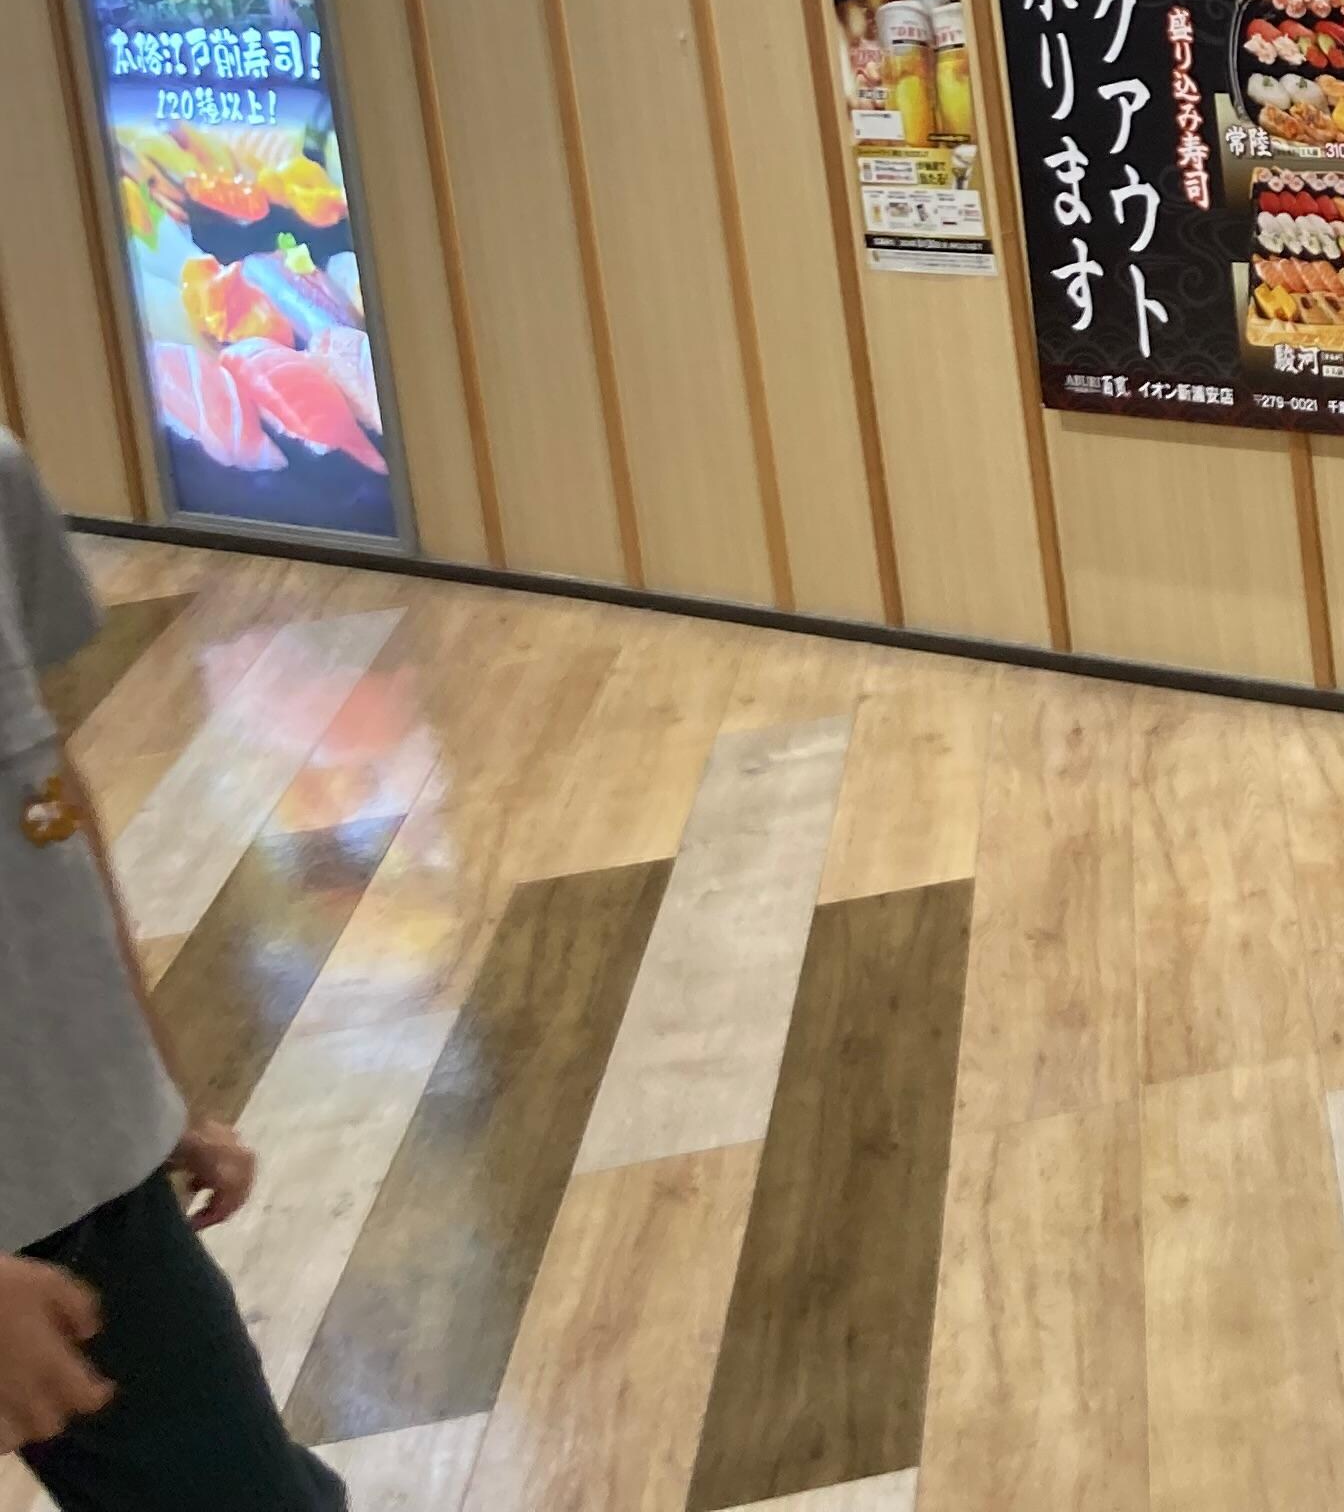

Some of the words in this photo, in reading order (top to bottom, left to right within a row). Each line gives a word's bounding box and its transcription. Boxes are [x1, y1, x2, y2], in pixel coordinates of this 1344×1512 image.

[1165, 8, 1210, 210] 盛り込み寿司
[1225, 126, 1272, 158] 常陸
[1138, 381, 1234, 406] イオン新浦安店
